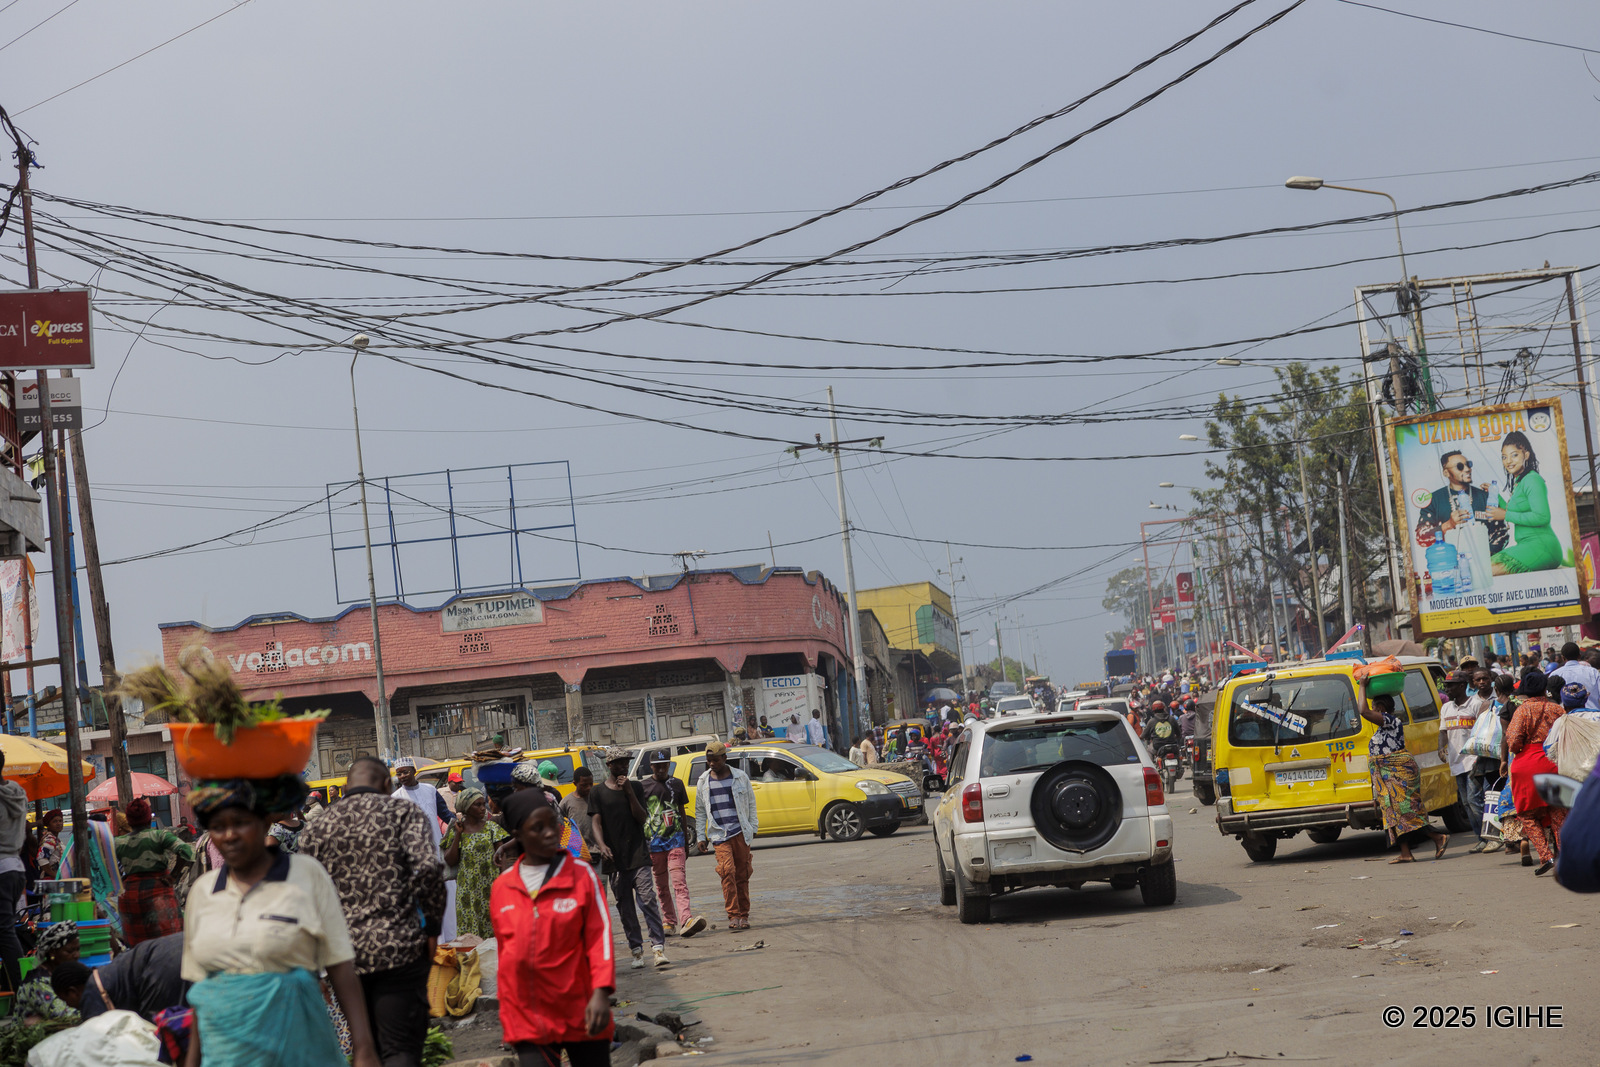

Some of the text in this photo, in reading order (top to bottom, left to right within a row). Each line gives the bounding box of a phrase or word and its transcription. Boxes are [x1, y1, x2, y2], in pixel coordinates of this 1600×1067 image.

[30, 320, 84, 337] eXpress
[23, 413, 73, 424] EXESS
[1417, 411, 1527, 446] UZIMA BORA
[1429, 585, 1569, 611] MODÉREZ VOTRE SOIF AVEC UZIMA BORA
[227, 641, 372, 673] vodacom
[764, 677, 801, 688] TECNO
[1326, 741, 1355, 752] TBG
[1331, 752, 1352, 763] 711
